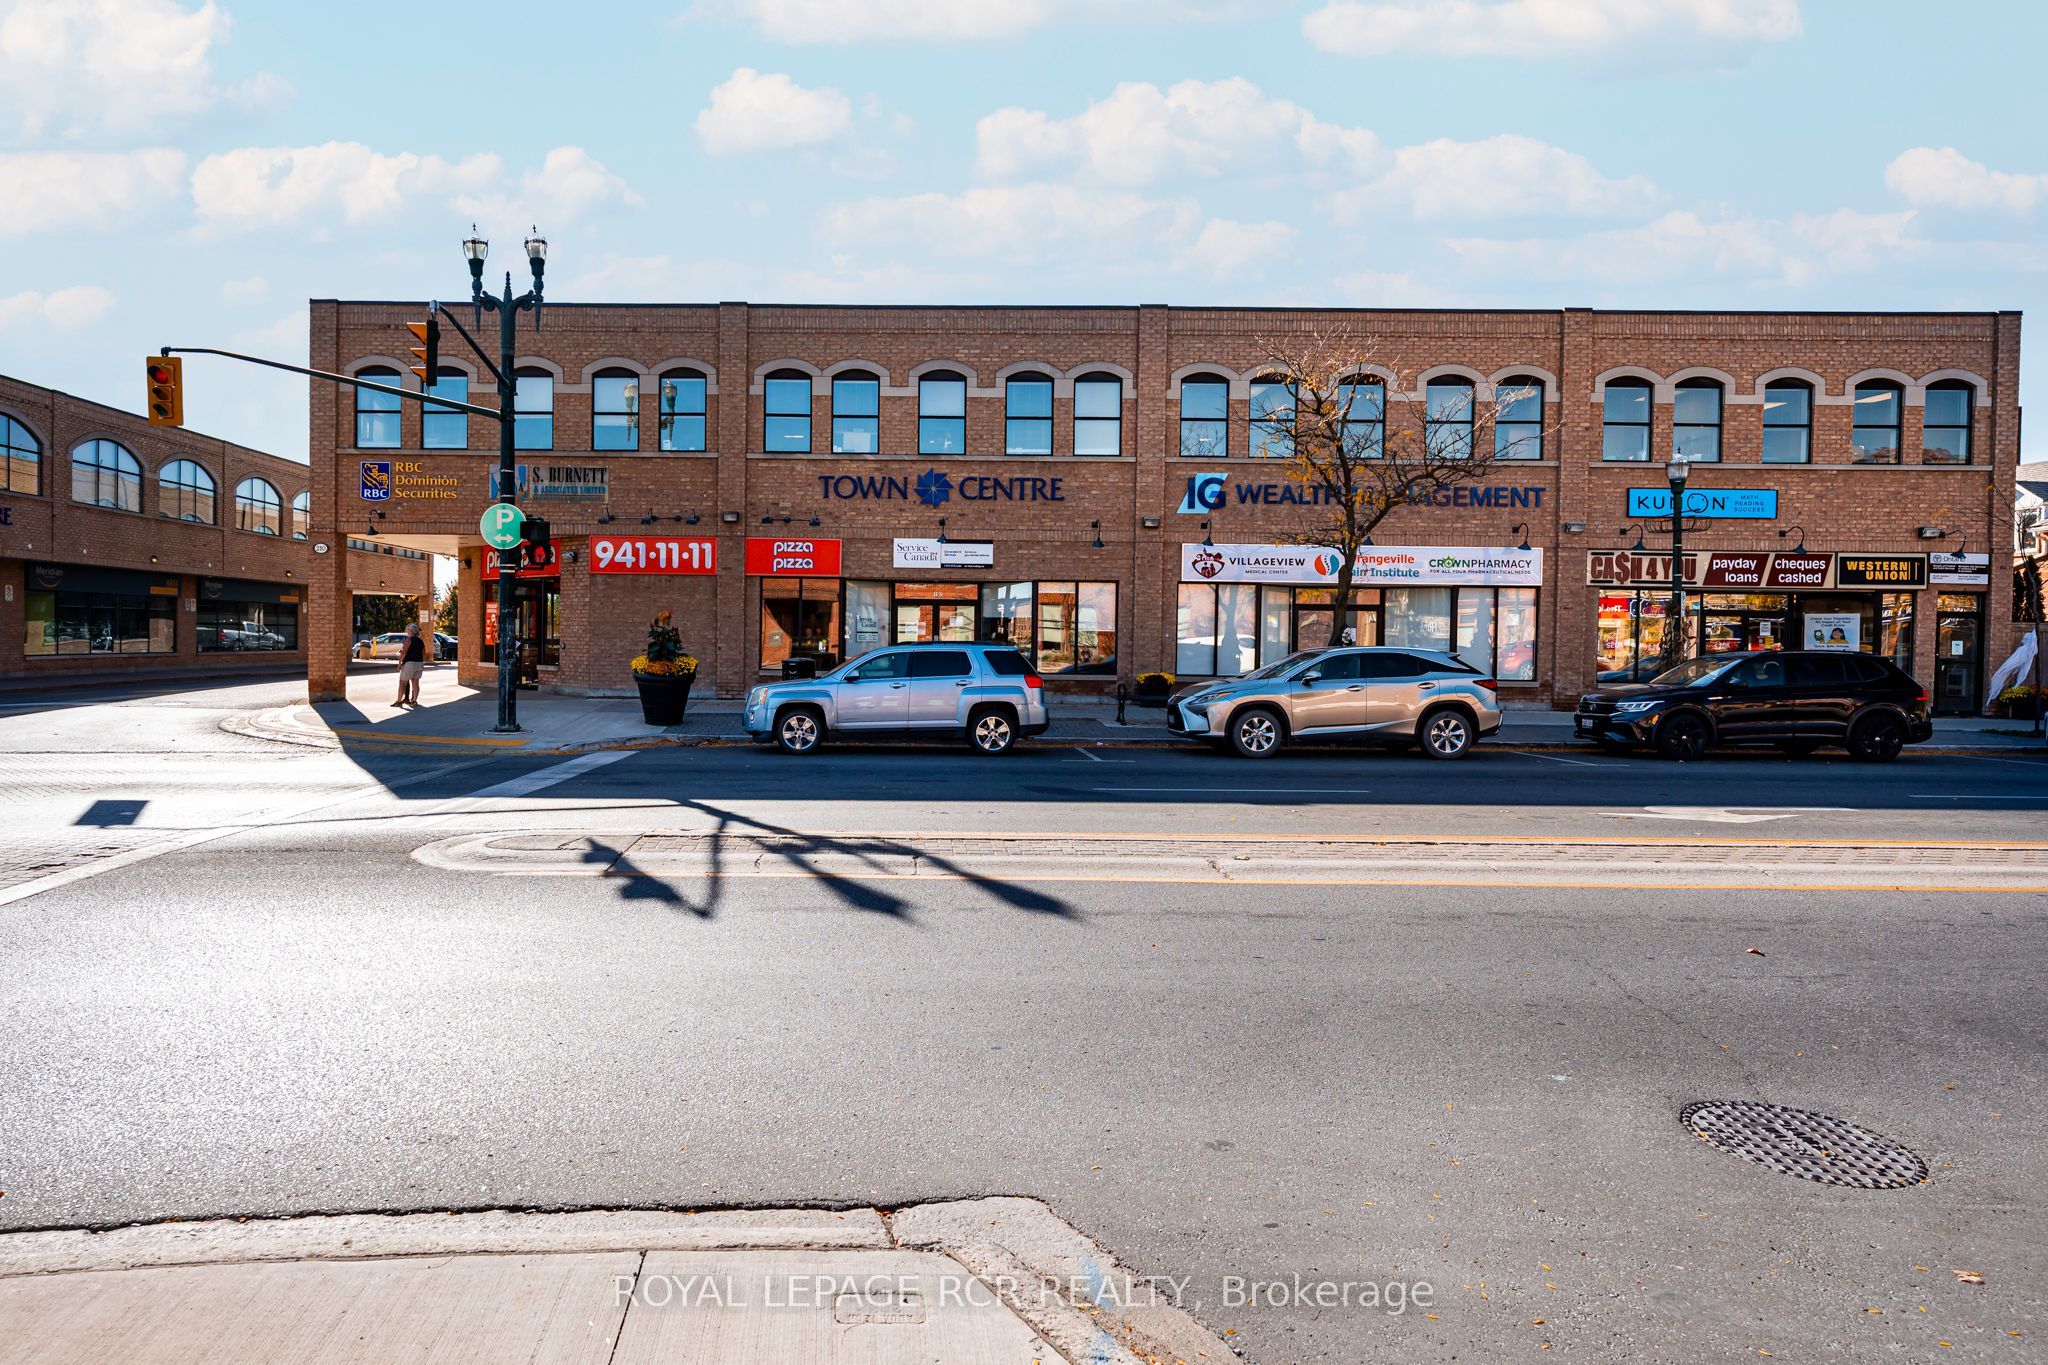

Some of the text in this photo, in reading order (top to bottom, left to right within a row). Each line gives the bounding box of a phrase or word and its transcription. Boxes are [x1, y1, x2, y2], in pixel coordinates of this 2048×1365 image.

[395, 462, 423, 473] RBC
[395, 474, 458, 486] Dominion
[532, 467, 607, 483] S. BURNETT
[364, 489, 387, 498] RBC
[395, 488, 457, 498] Securities
[819, 475, 1064, 501] TOWN CENTRE
[1187, 477, 1227, 509] IG
[1236, 484, 1546, 507] WEALTH AGEMENT
[496, 509, 514, 529] P
[773, 541, 813, 556] pizza
[897, 543, 928, 551] Service
[904, 552, 937, 561] Canada
[1229, 557, 1306, 566] VILLAGEVIEW
[1355, 554, 1414, 565] rangeville
[773, 558, 813, 572] pizza
[1646, 558, 1658, 579] 4
[1713, 558, 1757, 570] payday
[1775, 558, 1826, 570] cheques
[1846, 561, 1908, 570] WESTERN
[1351, 567, 1419, 577] ain Institute
[1725, 572, 1758, 582] loans
[1778, 572, 1822, 583] cashed
[1866, 571, 1908, 580] UNION
